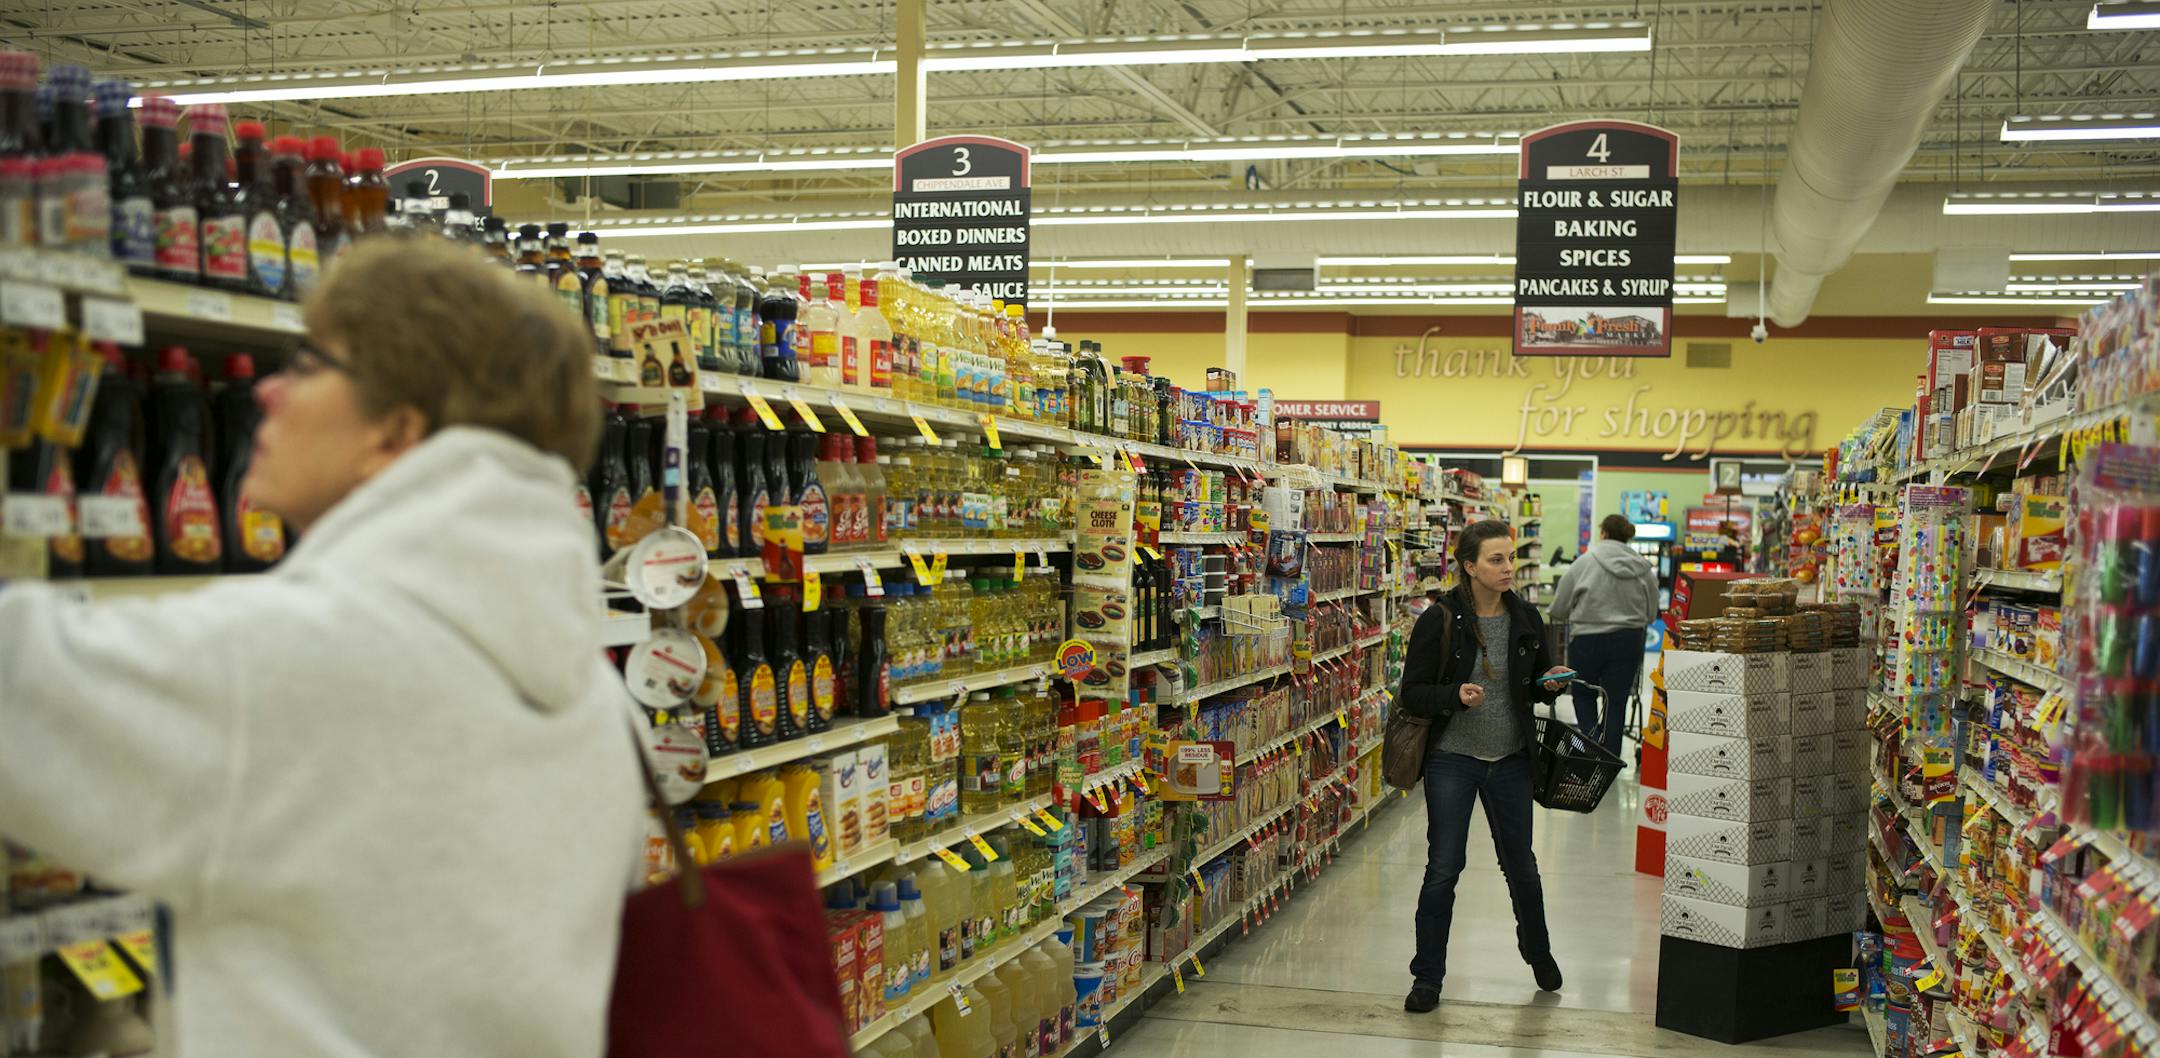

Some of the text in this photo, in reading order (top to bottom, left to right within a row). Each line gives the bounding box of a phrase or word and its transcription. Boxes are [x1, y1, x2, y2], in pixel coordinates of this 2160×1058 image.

[1586, 132, 1611, 163] 4
[951, 147, 972, 176] 3
[1569, 167, 1608, 178] LARCH
[424, 169, 441, 195] 2
[917, 179, 981, 190] CHIPPENDALE
[1523, 190, 1673, 208] FLOUR & SUGAR
[895, 200, 1023, 218] INTERNATIONAL
[897, 227, 1026, 245] BOXED DINNERS
[1554, 220, 1637, 237] BAKING
[896, 255, 1024, 272] CANNED MEATS
[1559, 249, 1631, 267] SPICES
[972, 282, 1024, 298] SAUCE
[1519, 278, 1670, 296] PANCAKES & SYRUP
[1594, 318, 1641, 334] Fresh
[1545, 356, 1637, 400] you
[1315, 404, 1367, 416] SERVICE
[1501, 384, 1818, 463] for shopping
[1725, 467, 1735, 485] 2
[1090, 511, 1117, 520] CHEESE
[1091, 519, 1115, 528] CLOTH
[1058, 650, 1093, 670] LOW
